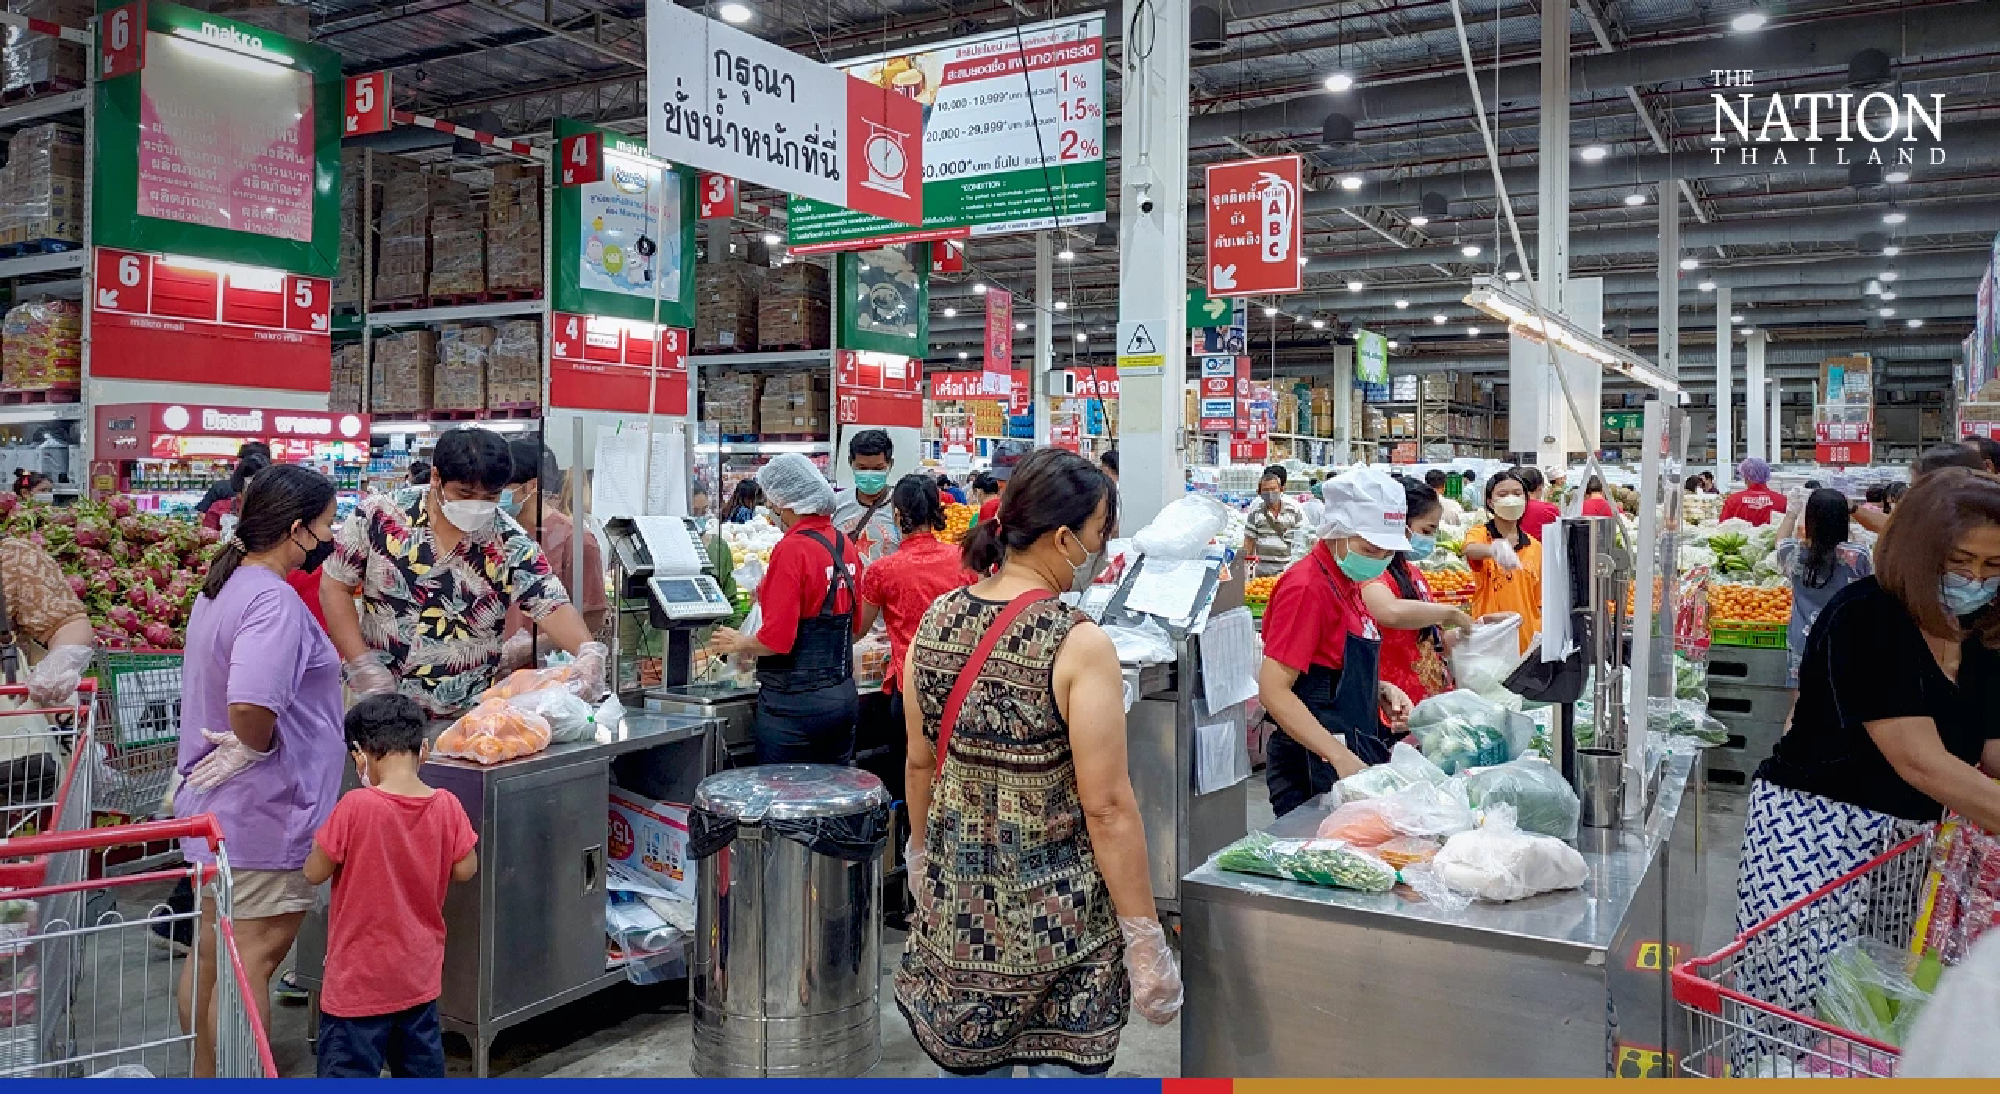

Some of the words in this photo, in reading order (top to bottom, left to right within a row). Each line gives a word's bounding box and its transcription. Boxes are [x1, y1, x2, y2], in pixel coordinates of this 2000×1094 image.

[112, 10, 129, 50] 6
[202, 22, 262, 49] makro
[1008, 43, 1096, 70] แผนกอาหารสด
[714, 49, 795, 105] กรุณา
[355, 77, 374, 113] 5
[664, 76, 840, 181] ชั่งน้ำหนักที่นี่
[571, 136, 588, 166] 4
[709, 176, 726, 203] 3
[1268, 199, 1281, 215] A
[1269, 221, 1281, 236] B
[1268, 241, 1279, 257] C
[119, 255, 141, 287] 6
[294, 279, 313, 308] 5
[130, 317, 162, 329] makro
[254, 331, 282, 341] makro
[565, 316, 579, 340] 4
[666, 330, 678, 353] 3
[846, 352, 854, 371] 2
[908, 361, 916, 378] 1
